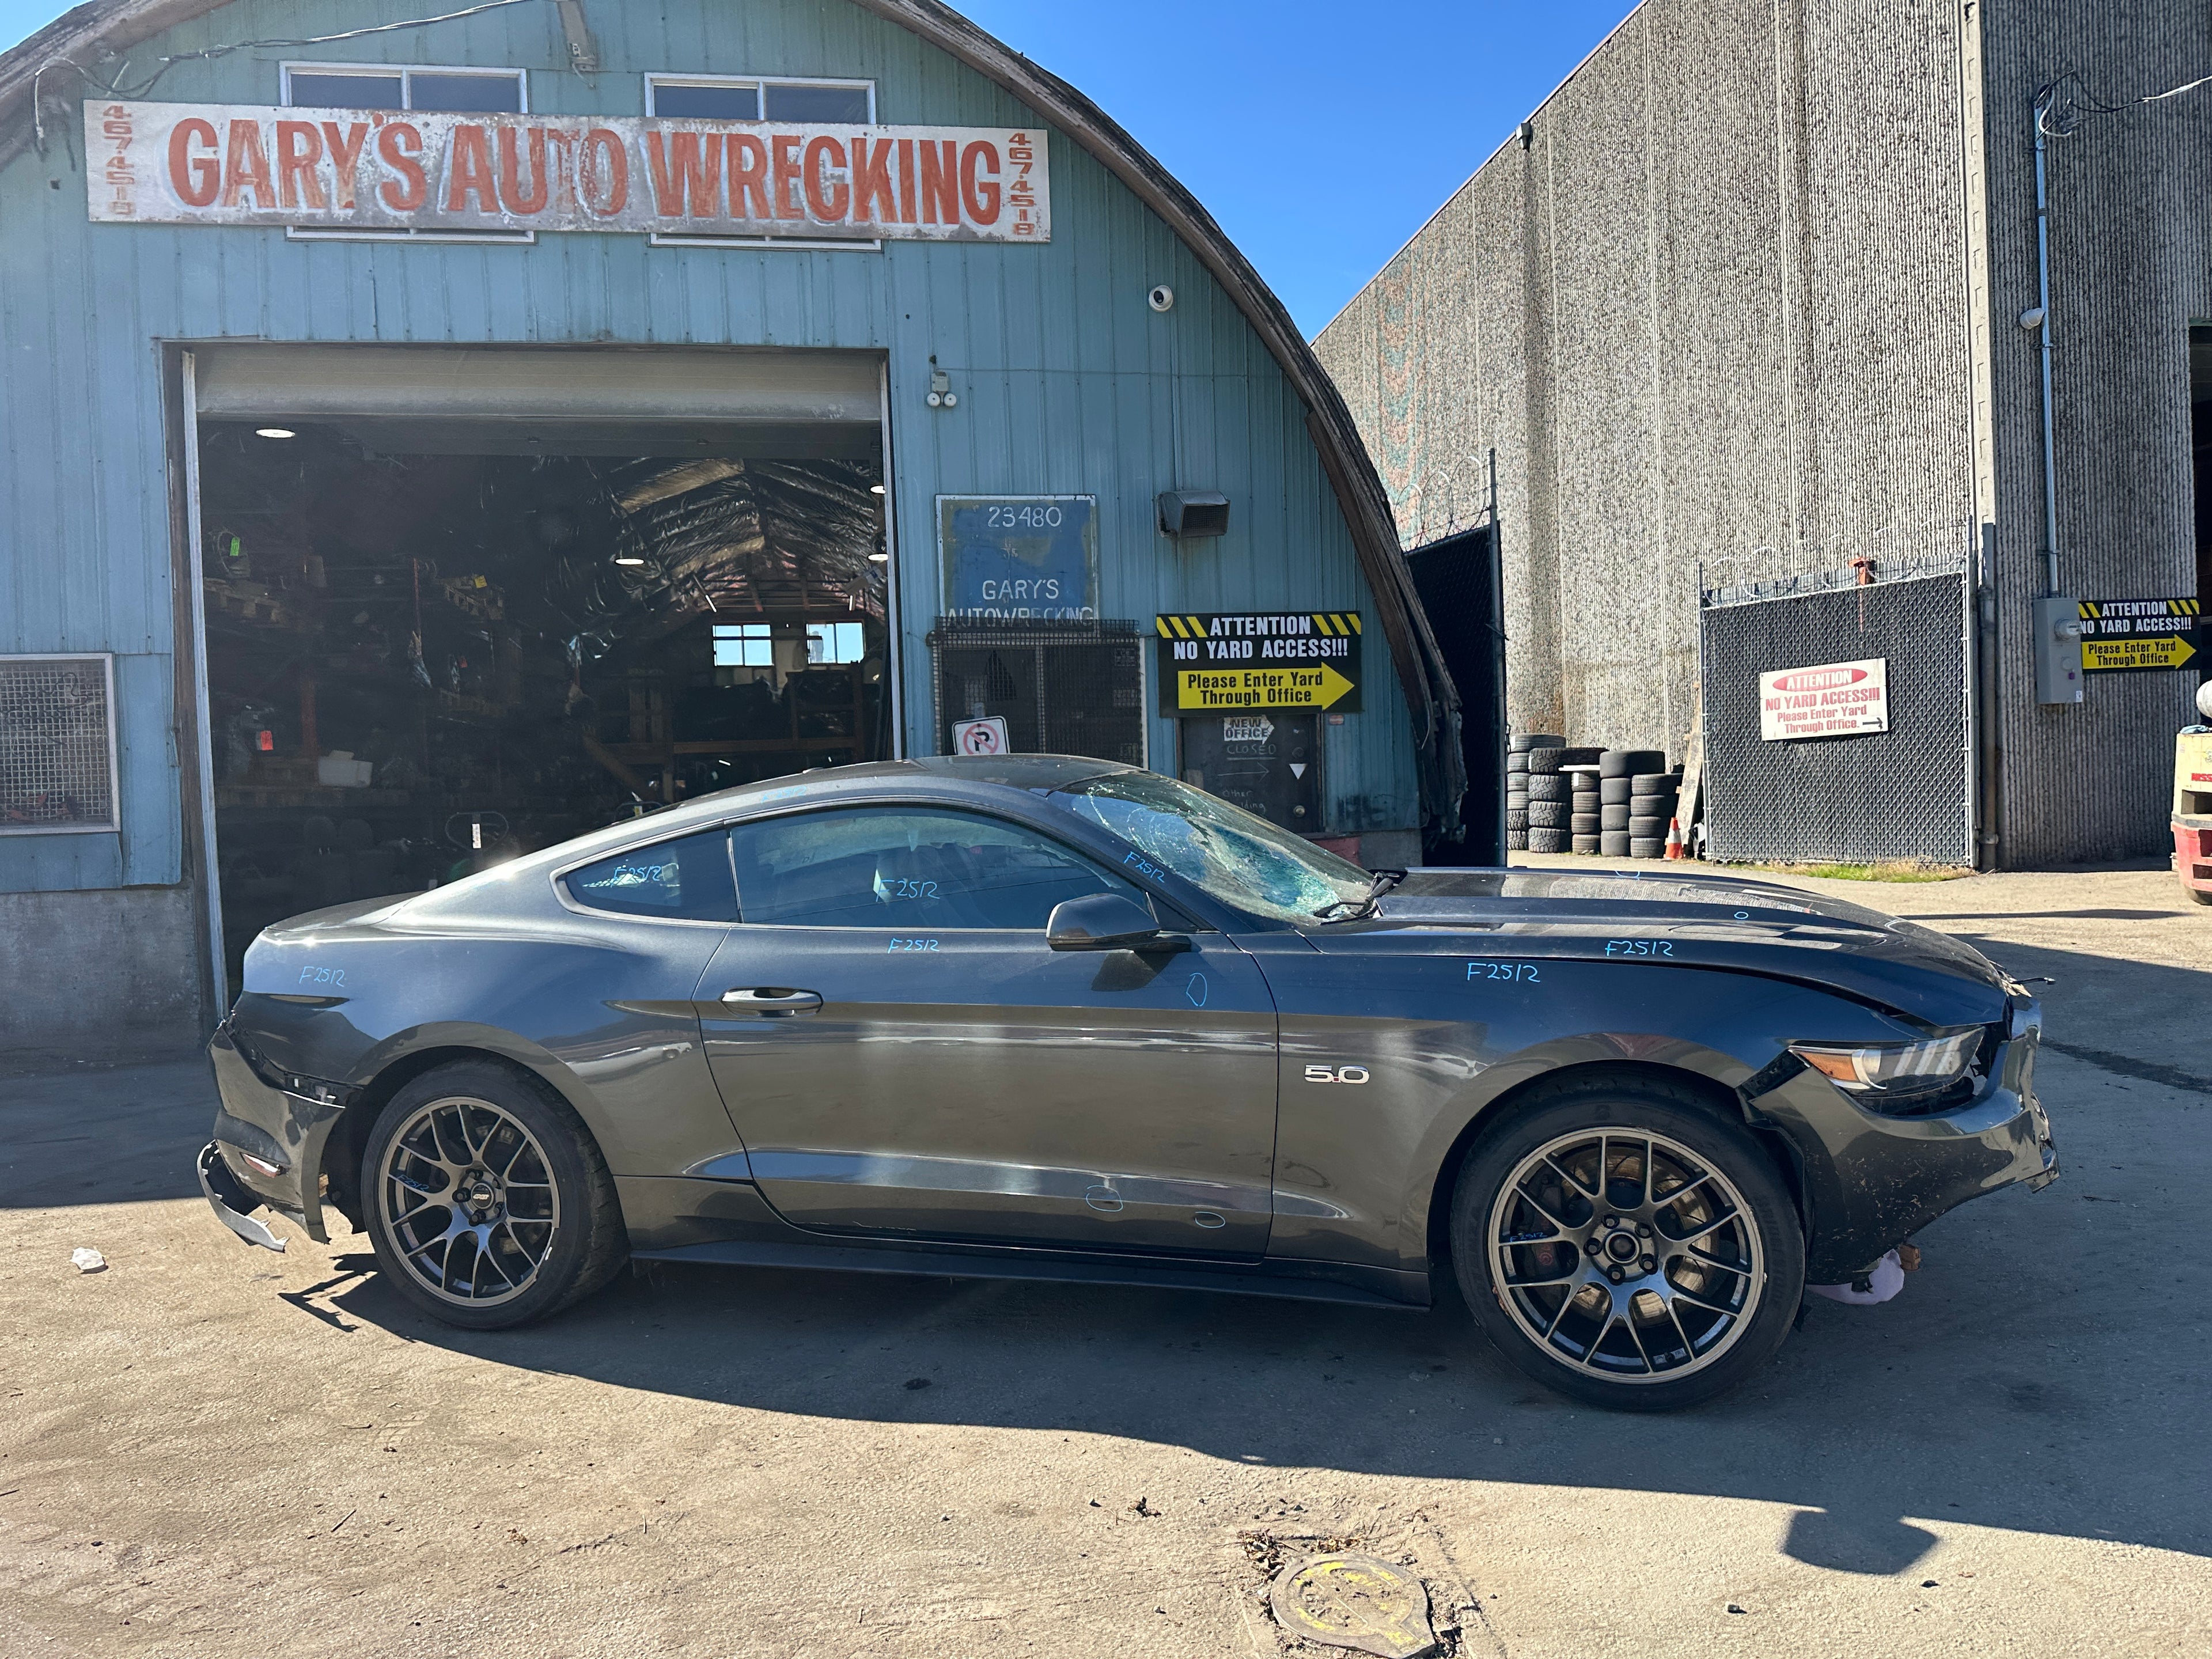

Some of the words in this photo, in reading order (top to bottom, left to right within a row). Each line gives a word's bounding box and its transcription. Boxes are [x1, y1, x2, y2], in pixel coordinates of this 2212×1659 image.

[168, 113, 427, 213] GARY'S
[447, 125, 629, 216] AUTO
[646, 131, 1001, 226] WRECKING
[987, 506, 1062, 528] 23480
[982, 578, 1059, 600] GARY'S
[2101, 601, 2168, 617] ATTENTION
[1210, 616, 1311, 637] ATTENTION
[2080, 620, 2095, 634] NO
[2100, 619, 2130, 633] YARD
[2135, 617, 2192, 632] ACCESS!!!
[1173, 641, 1198, 660] NO
[1206, 640, 1253, 659] YARD
[1261, 638, 1349, 658] ACCESS!!!
[2088, 643, 2120, 654] Please
[2125, 642, 2150, 653] Enter
[2155, 641, 2176, 652] Yard
[2097, 654, 2136, 666] Through
[2140, 653, 2169, 664] Office
[1188, 673, 1237, 689] Please
[1244, 672, 1284, 687] Enter
[1290, 671, 1323, 686] Yard
[1786, 669, 1853, 690] ATTENTION
[1200, 690, 1260, 706] Through
[1267, 688, 1312, 703] Office
[1766, 698, 1781, 711] NO
[1784, 694, 1817, 709] YARD
[1820, 687, 1880, 706] ACCESS!!!
[1777, 710, 1808, 722] Please
[1810, 708, 1838, 719] Enter
[1841, 704, 1867, 717] Yard
[1230, 717, 1262, 728] NEW
[1785, 720, 1824, 734] Through
[1225, 727, 1268, 738] OFFICE
[1227, 744, 1277, 755] CLOSED
[1123, 851, 1165, 883] F2512
[876, 879, 941, 903] F2512
[888, 938, 940, 954] F2512
[1605, 941, 1673, 957] F2512
[299, 966, 346, 987] F2512
[1467, 963, 1541, 983] F2512
[1304, 1065, 1370, 1084] 5.0
